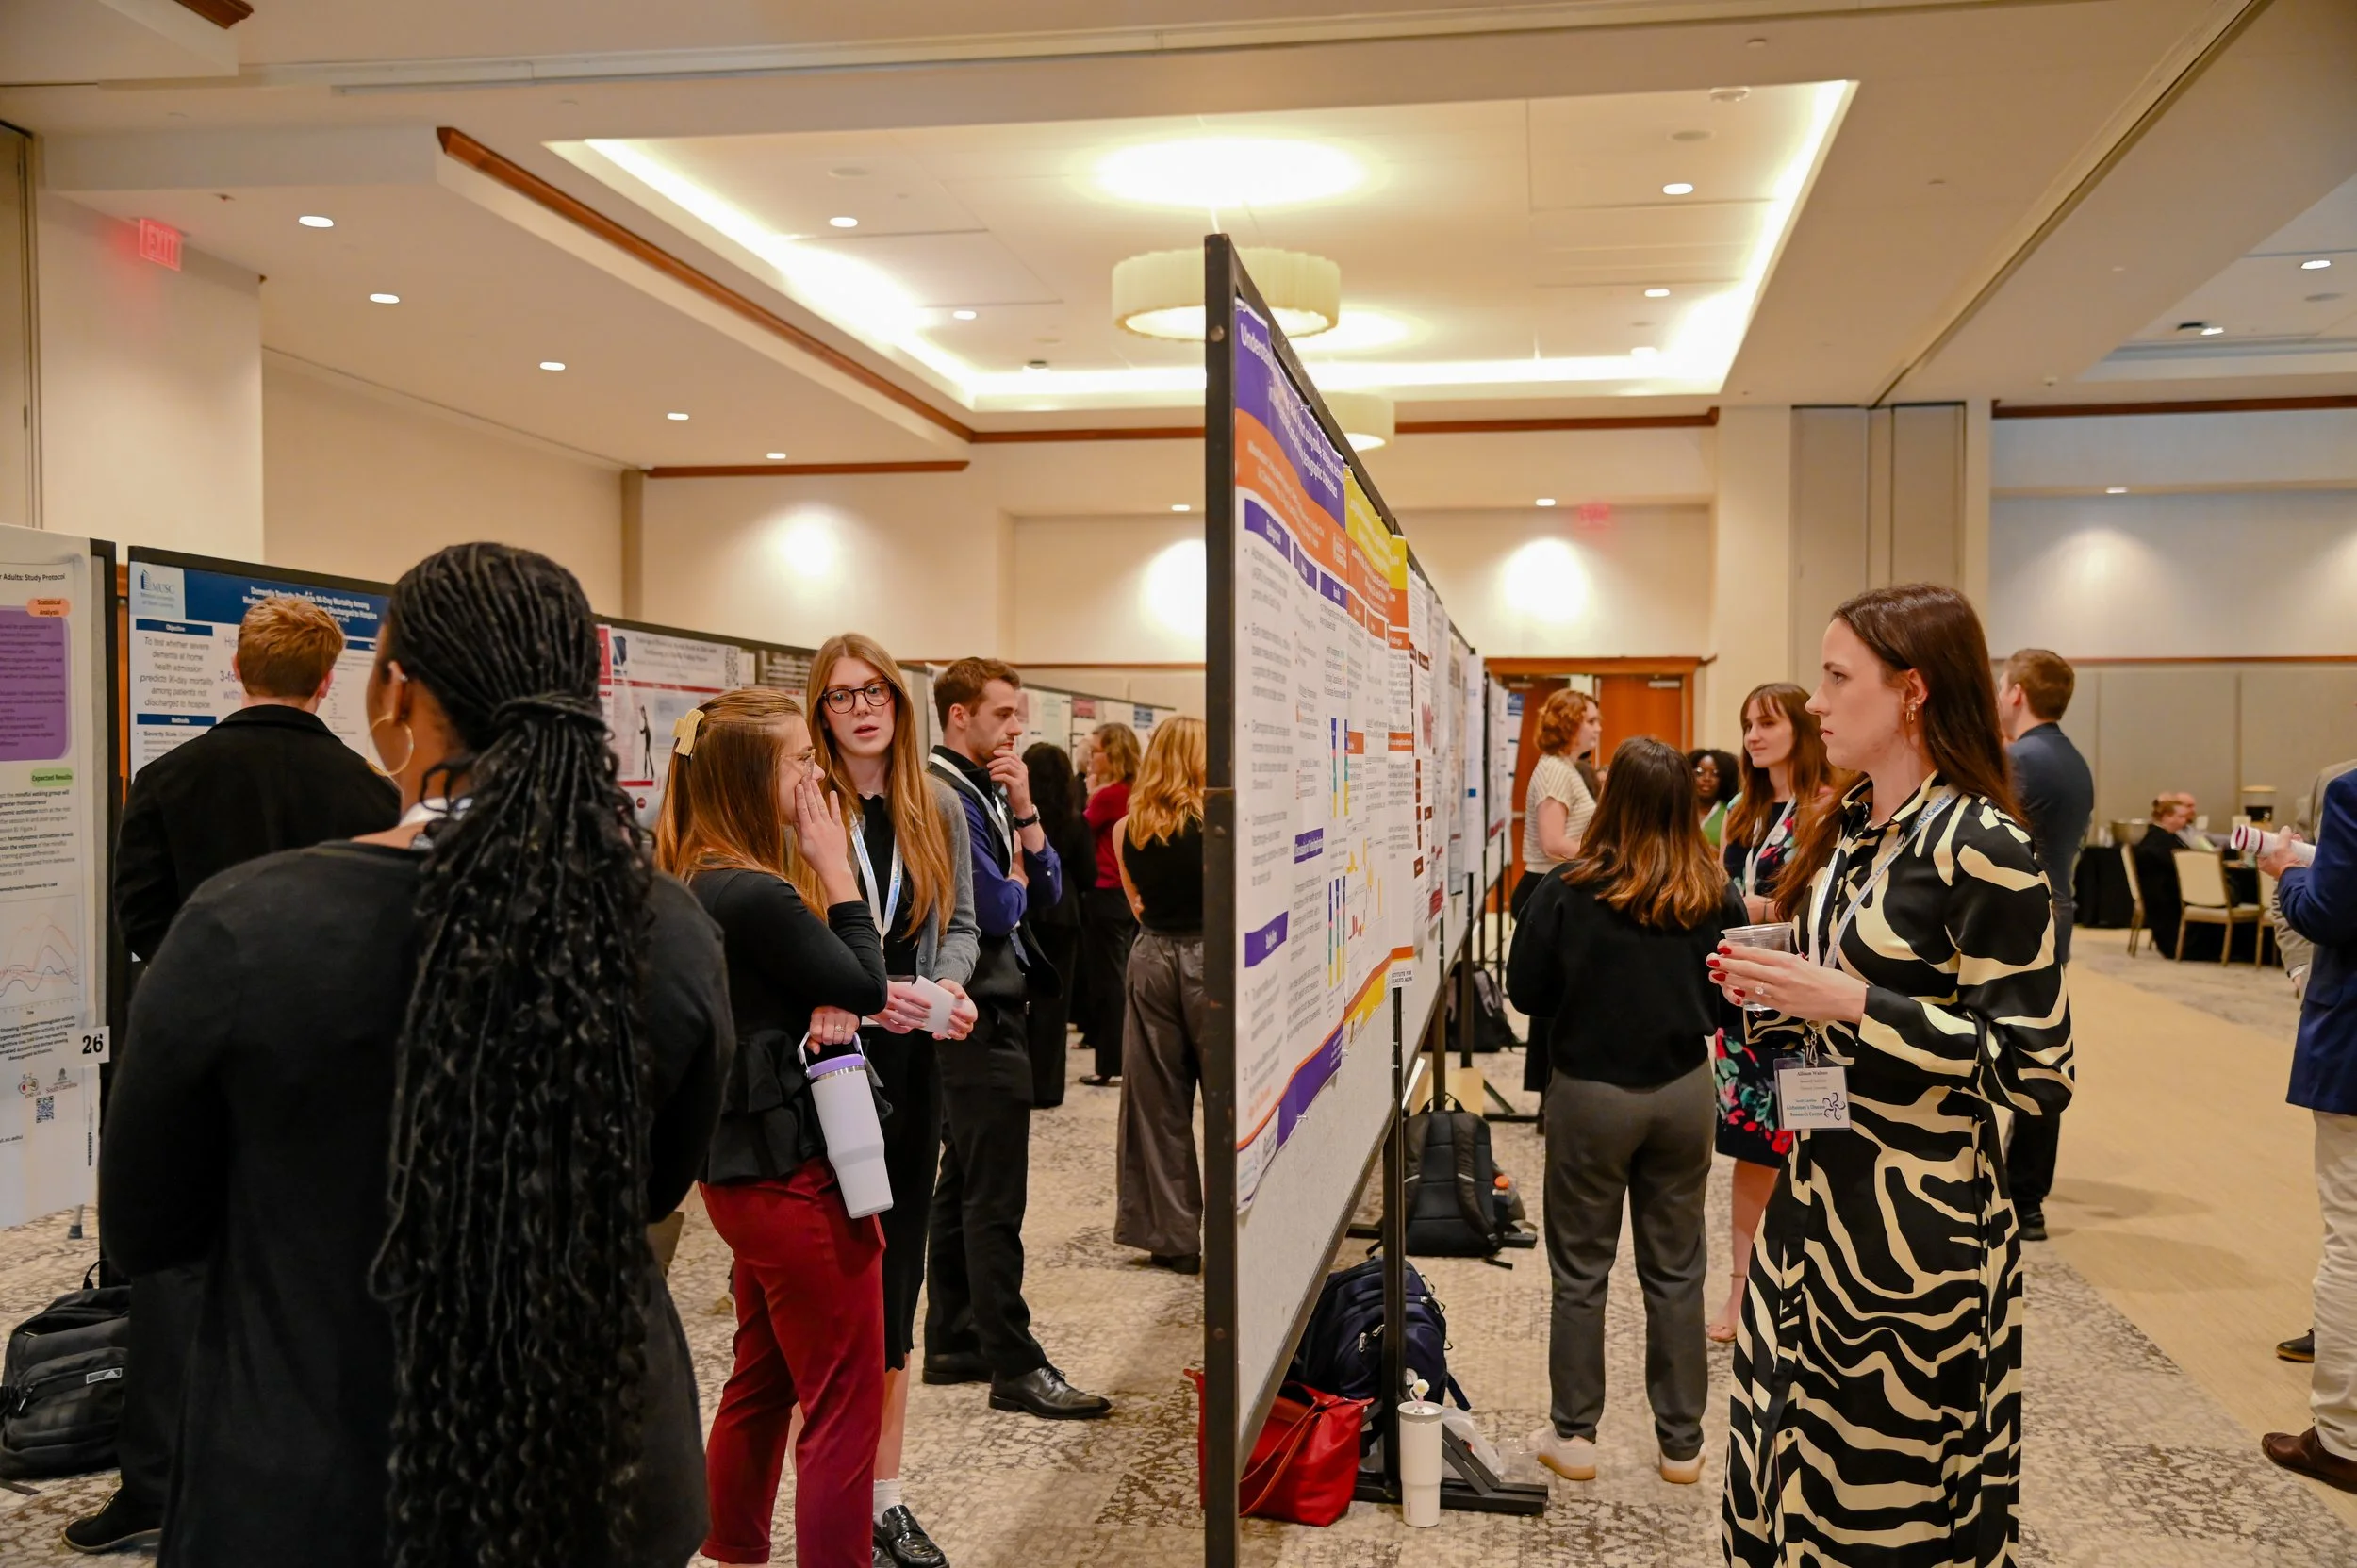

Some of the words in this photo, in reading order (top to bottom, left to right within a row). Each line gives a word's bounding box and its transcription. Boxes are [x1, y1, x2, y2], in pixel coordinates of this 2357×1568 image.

[25, 574, 41, 583] Study
[152, 582, 174, 594] MUSC
[140, 674, 167, 684] predicts
[1926, 793, 1951, 817] Center
[82, 1033, 104, 1054] 26
